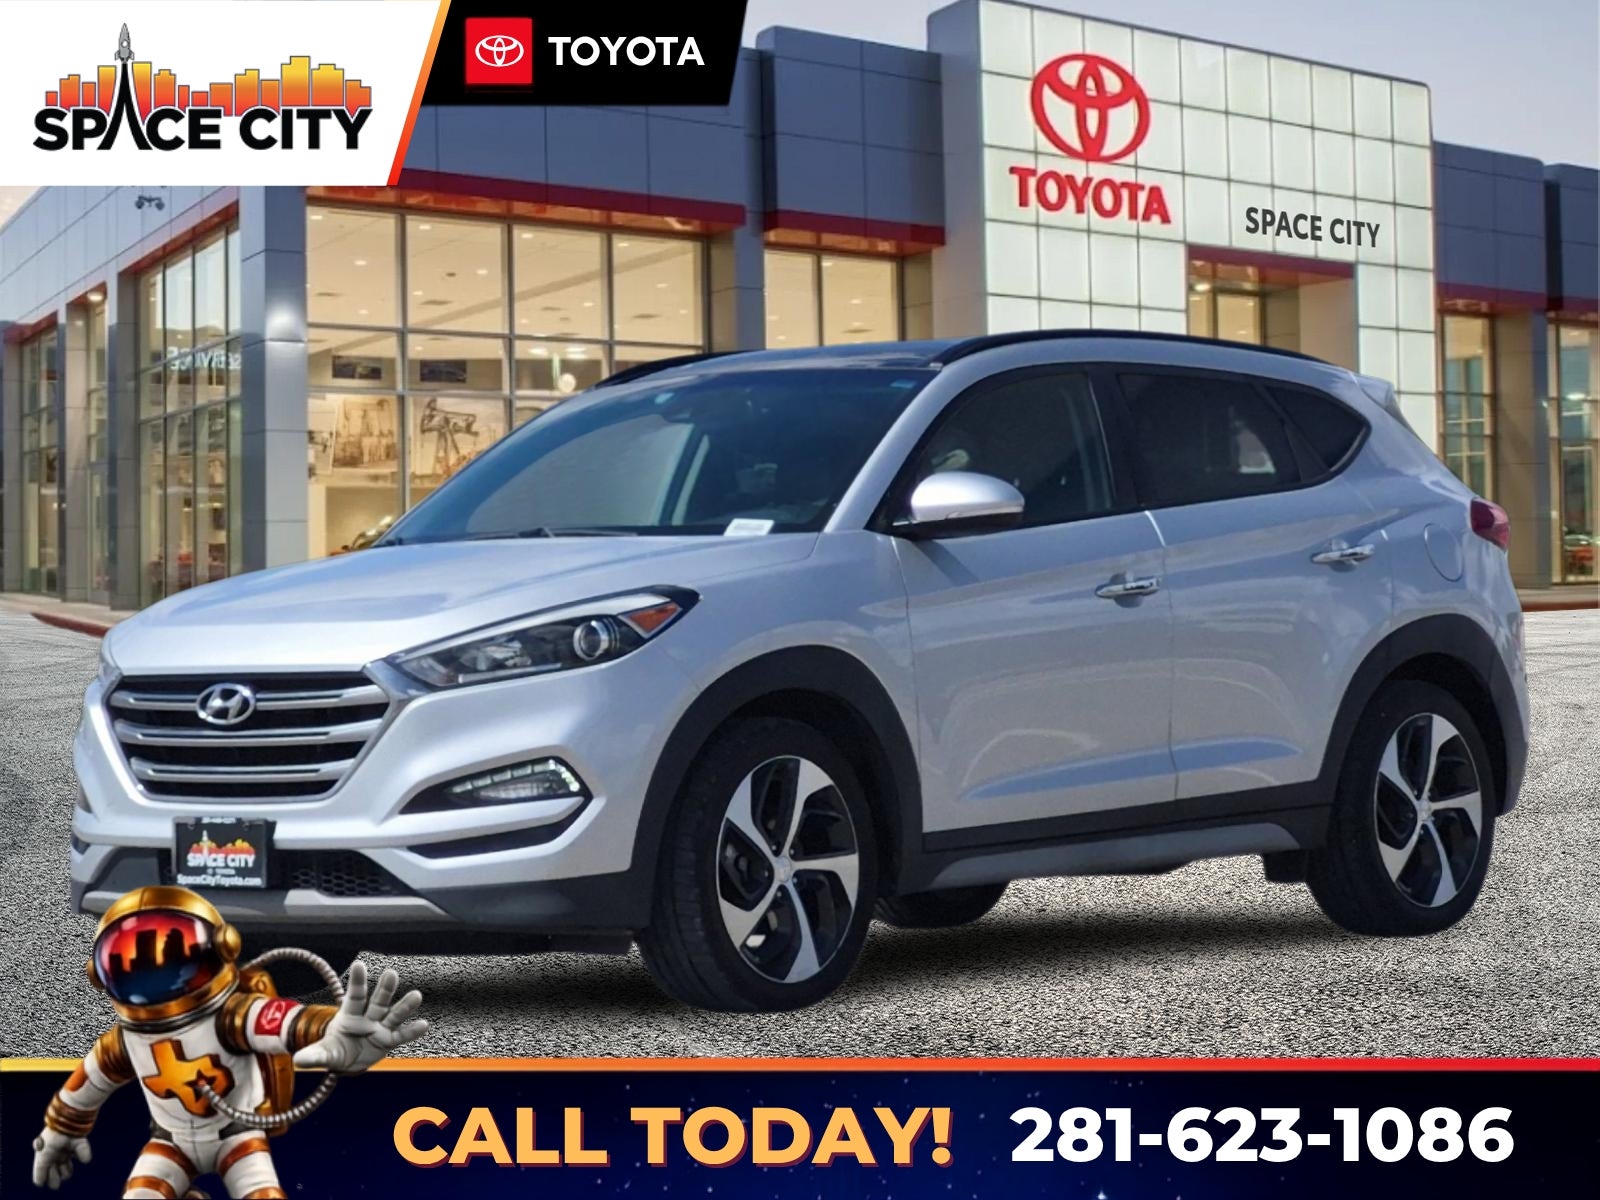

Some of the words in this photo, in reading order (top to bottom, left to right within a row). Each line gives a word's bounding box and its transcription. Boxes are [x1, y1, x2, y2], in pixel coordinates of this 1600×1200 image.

[1009, 166, 1171, 224] TOYOTA
[1245, 206, 1323, 241] SPACE
[1329, 218, 1381, 248] CITY
[187, 852, 225, 868] SPACE
[226, 853, 256, 868] CITY
